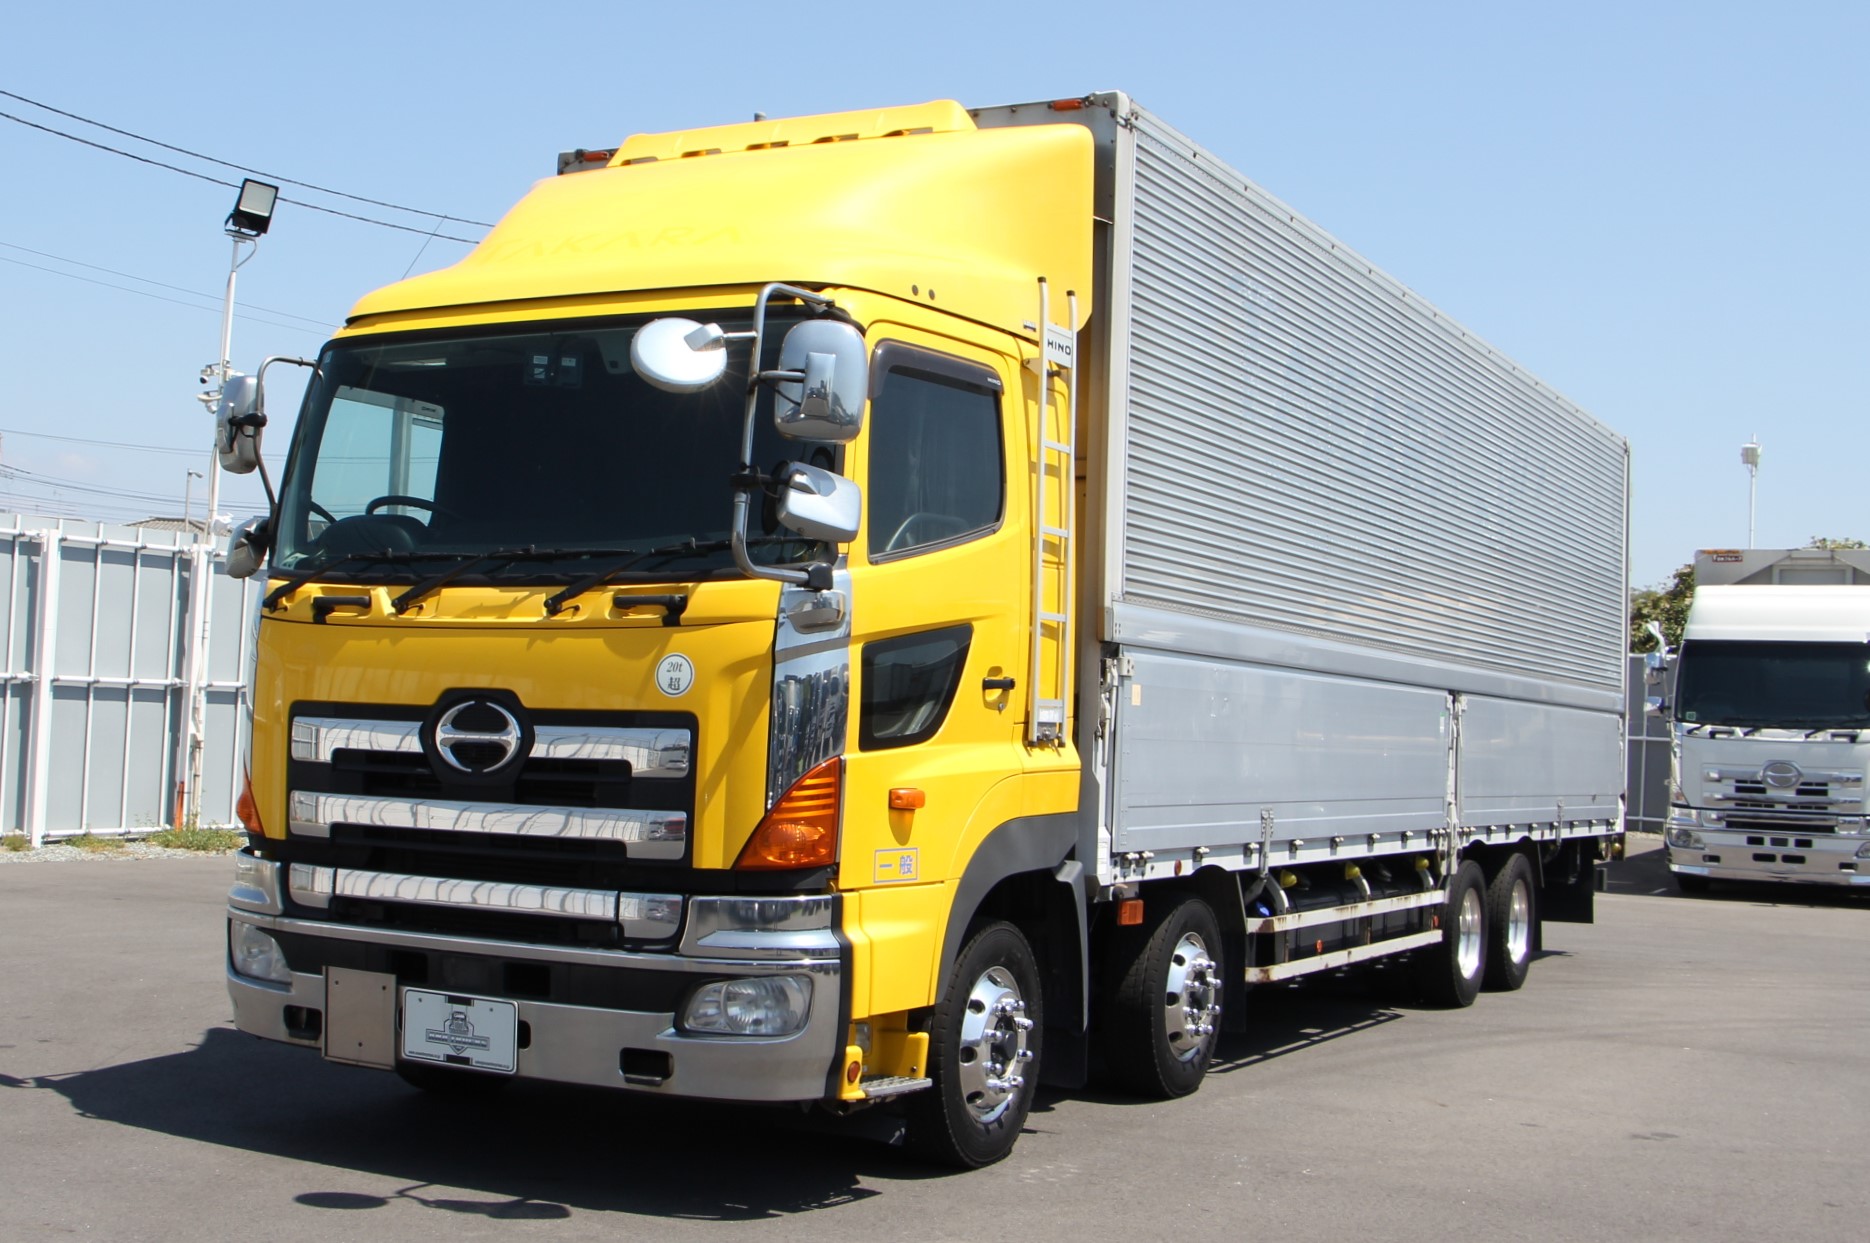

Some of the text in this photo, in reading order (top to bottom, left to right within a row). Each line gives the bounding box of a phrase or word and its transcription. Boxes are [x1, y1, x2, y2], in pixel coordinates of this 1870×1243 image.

[1047, 338, 1072, 356] HINO
[666, 661, 683, 673] 20t
[667, 676, 681, 691] 超
